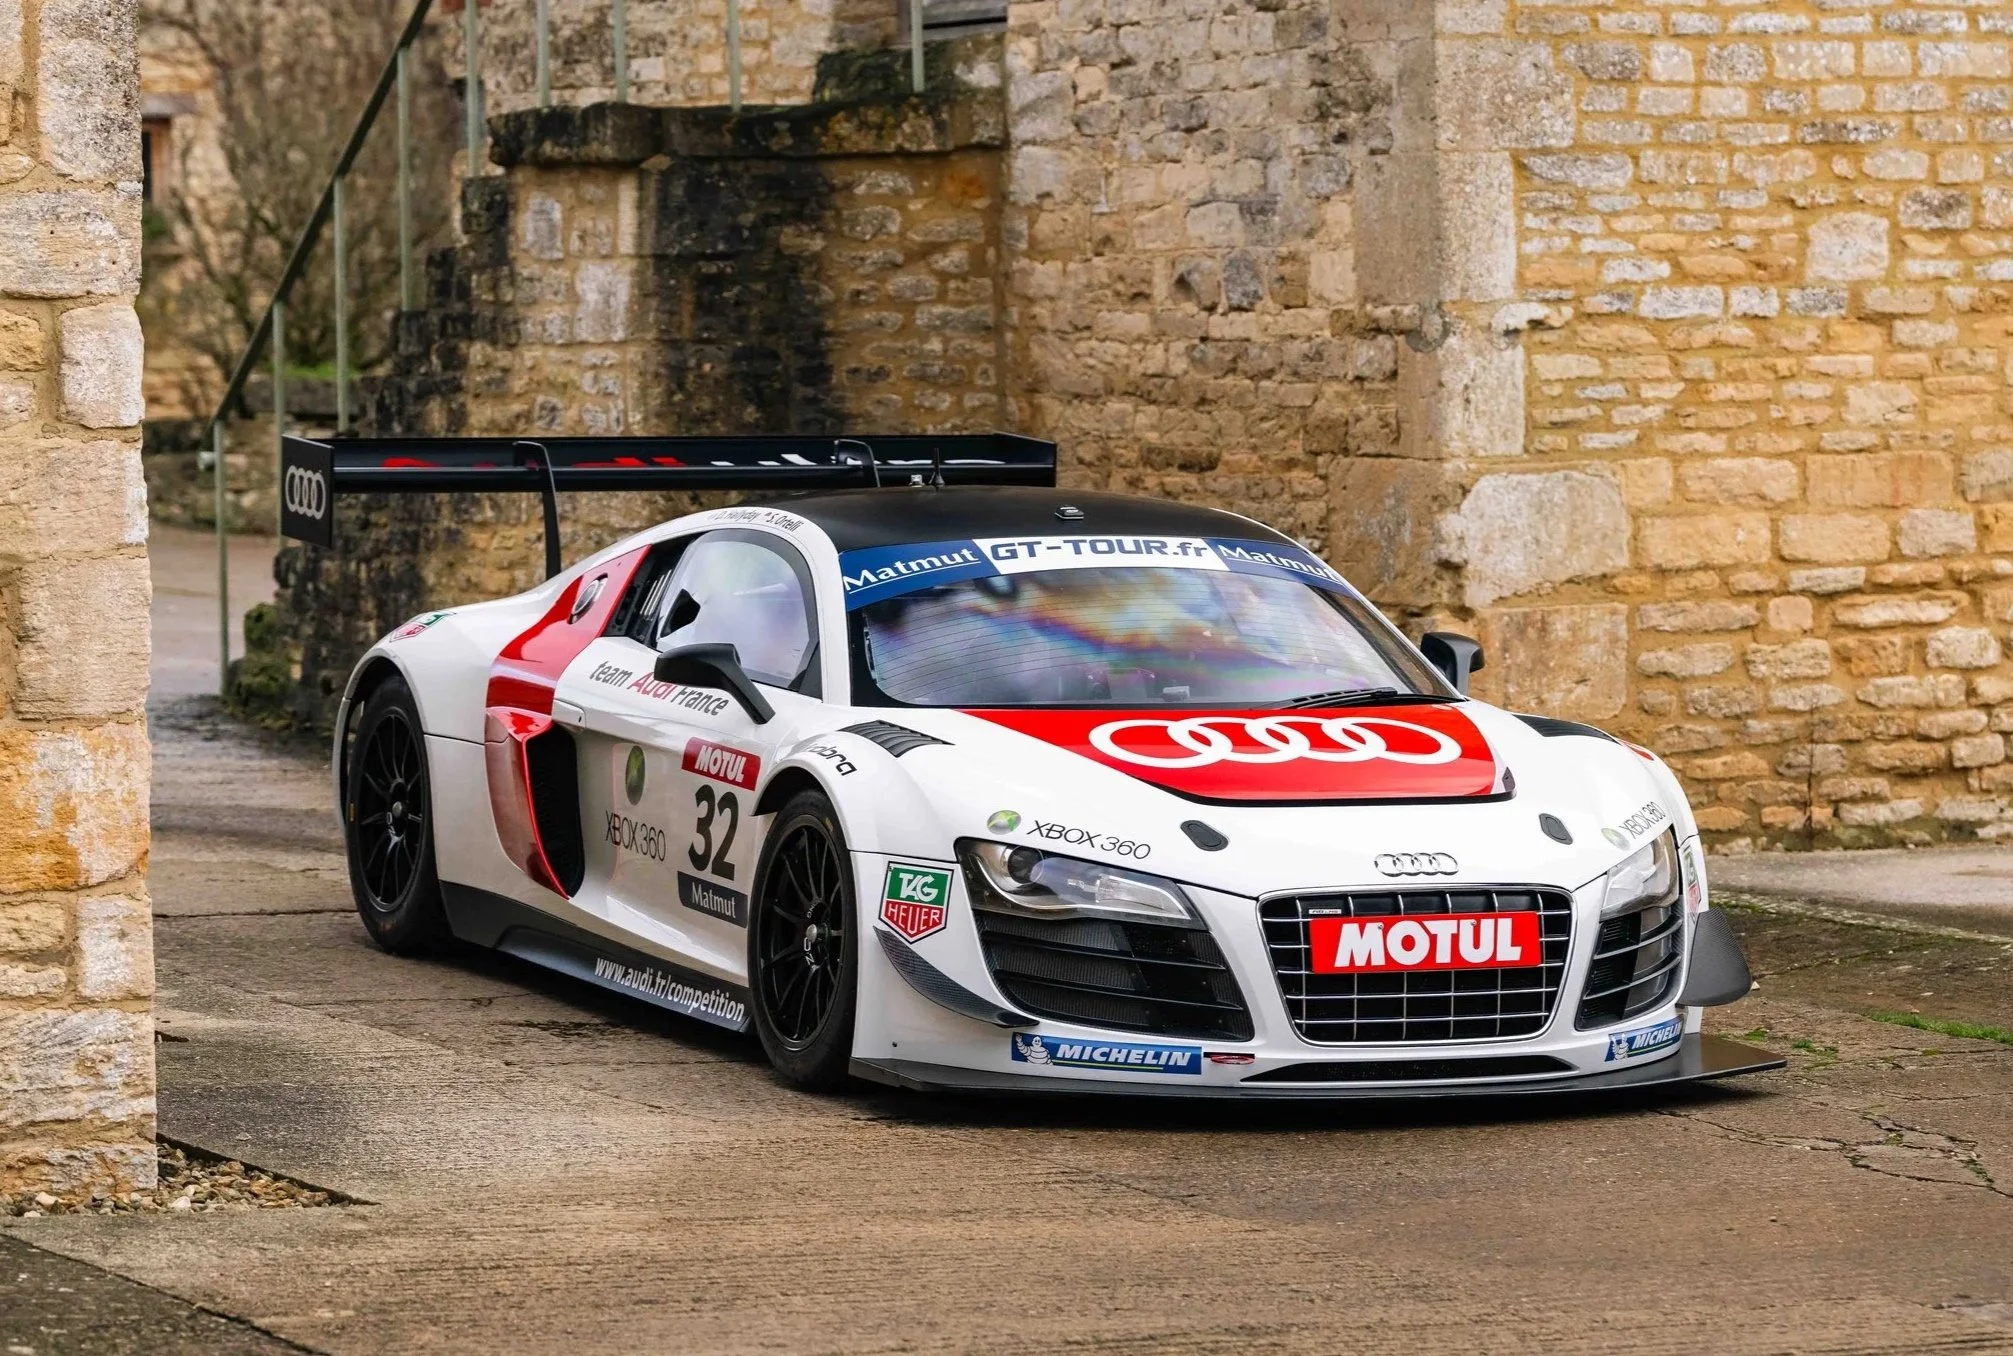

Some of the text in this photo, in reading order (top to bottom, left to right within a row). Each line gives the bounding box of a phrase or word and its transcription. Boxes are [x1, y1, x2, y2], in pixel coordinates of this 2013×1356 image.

[990, 538, 1207, 561] GT-TOUR.fr
[1218, 544, 1340, 582] Matmut
[842, 548, 980, 592] Matmut
[589, 660, 633, 688] team
[670, 686, 730, 716] France
[694, 744, 747, 783] MOTUL
[605, 809, 667, 862] XBOX 360
[687, 784, 740, 881] 32
[1026, 820, 1151, 860] XBOX 360
[1618, 801, 1667, 840] XBOX 360
[691, 882, 737, 919] Matmut
[898, 872, 939, 903] TAG
[887, 903, 941, 935] HEUER
[1333, 917, 1523, 969] MOTUL
[594, 957, 745, 1022] www.audi.fr/competition
[1056, 1044, 1192, 1066] MICHELIN
[1631, 1021, 1683, 1050] MICHELIN
